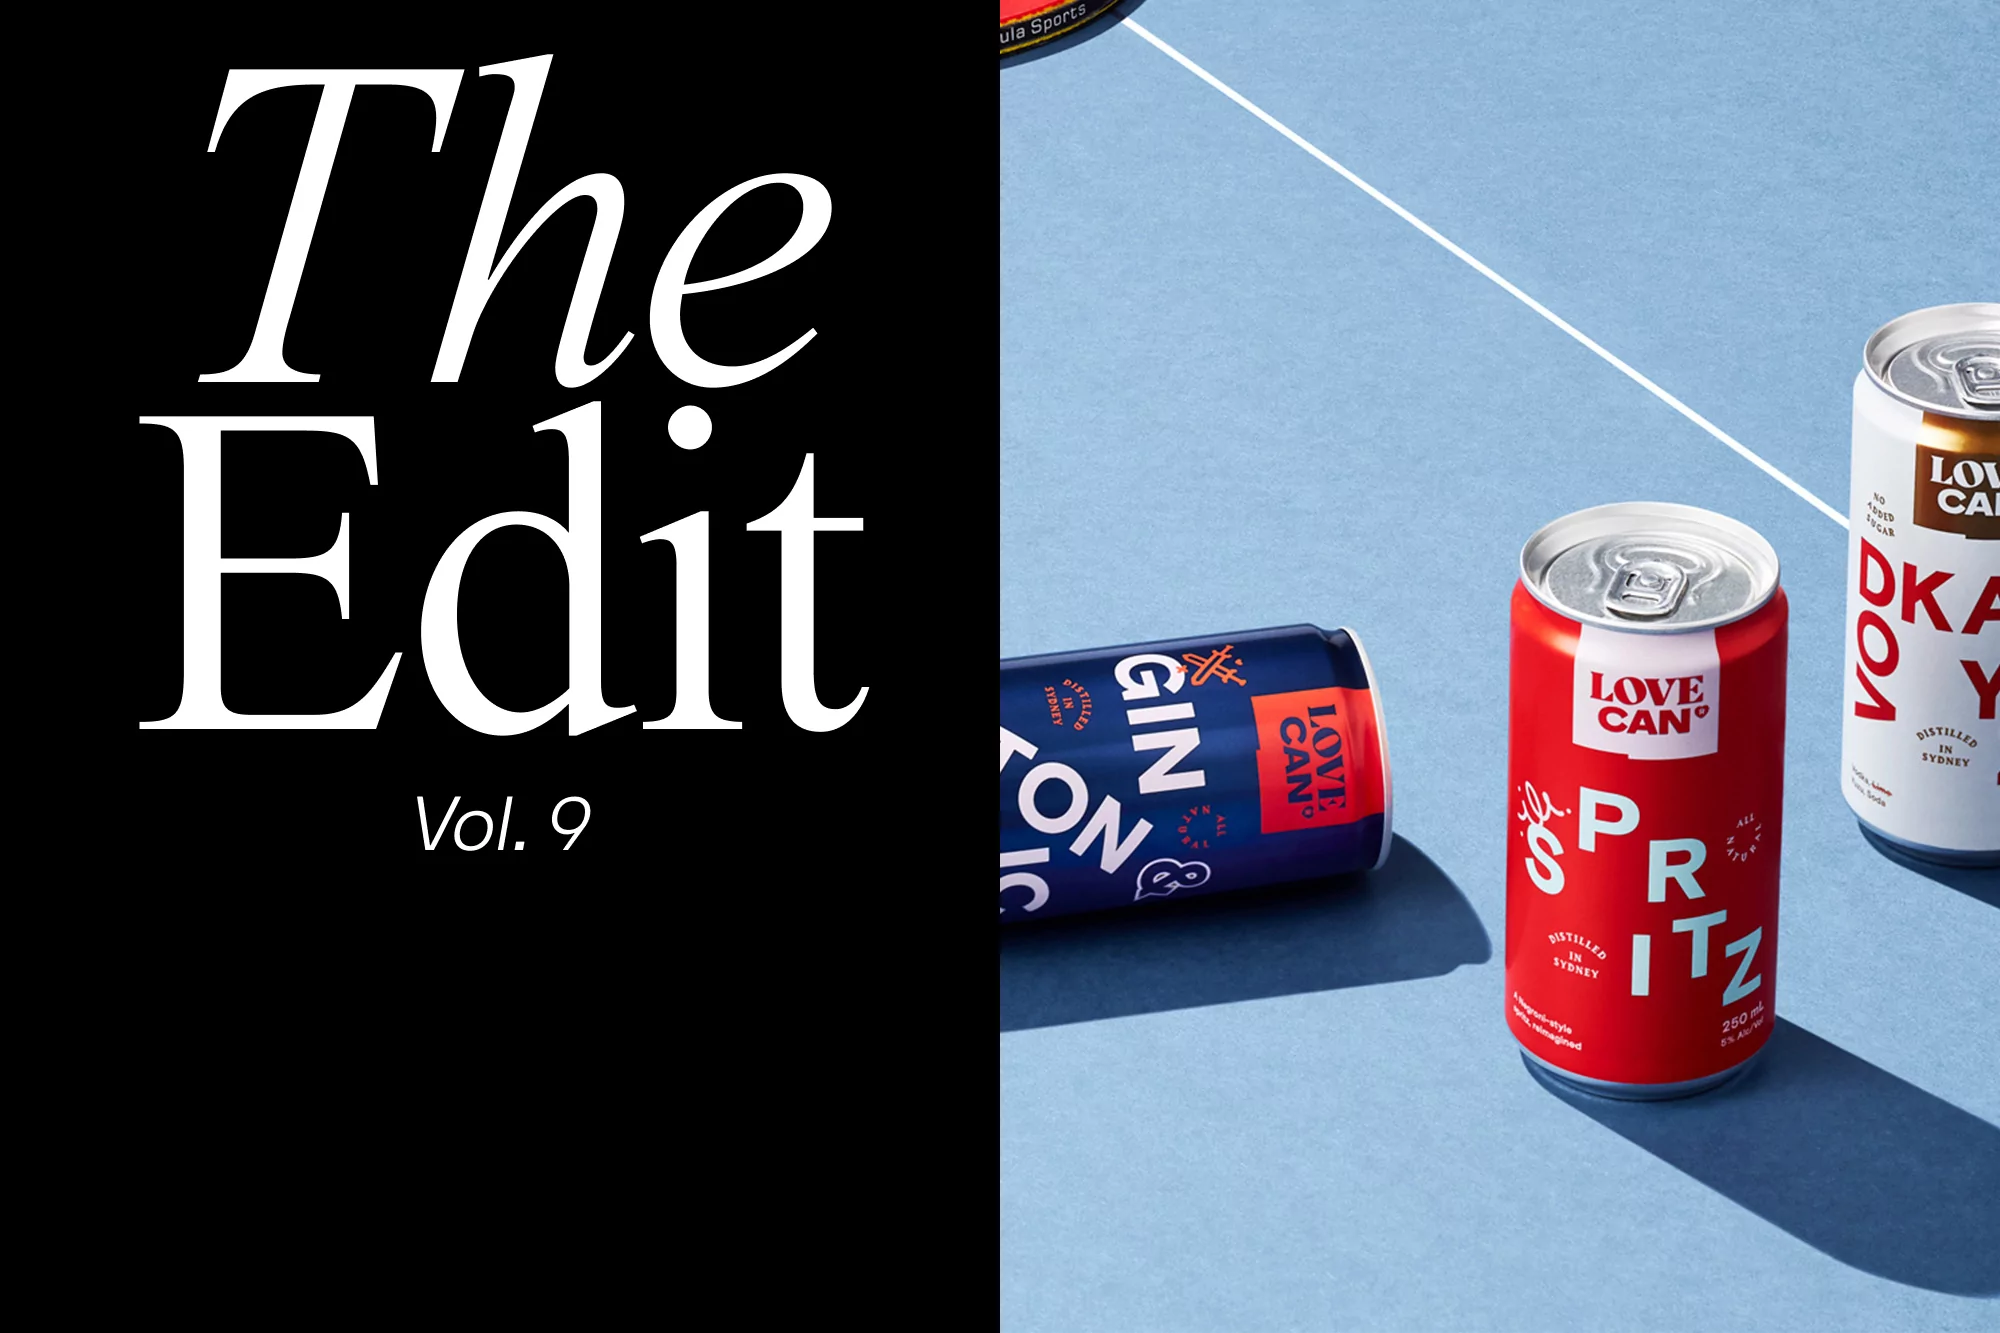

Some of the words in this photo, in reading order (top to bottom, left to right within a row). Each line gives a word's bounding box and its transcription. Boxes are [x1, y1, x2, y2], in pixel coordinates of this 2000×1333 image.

[1030, 3, 1087, 35] Sports
[1867, 501, 1895, 522] ADDED
[1873, 491, 1886, 505] NO
[1937, 488, 2000, 516] CA
[1866, 513, 1896, 537] SUGAR
[1590, 671, 1704, 706] LOVE
[1044, 686, 1063, 726] SYDNEY
[1062, 697, 1074, 709] IN
[1062, 678, 1092, 731] DISTILLED
[1114, 653, 1206, 795] GIN
[1597, 706, 1691, 735] CAN
[1916, 726, 1978, 748] DISTILLED
[1939, 744, 1953, 754] IN
[1280, 716, 1313, 804] CAN
[1307, 704, 1346, 811] LOVE
[1922, 752, 1970, 767] SYDNEY
[1177, 804, 1211, 849] NATURAL
[1215, 814, 1227, 837] ALL
[1736, 812, 1755, 828] ALL
[1726, 823, 1762, 862] NATURAL
[1548, 931, 1607, 960] DISTILLED
[1569, 950, 1582, 963] IN
[1553, 957, 1599, 979] SYDNEY
[1532, 1022, 1582, 1051] reimagined
[1722, 1012, 1748, 1033] 250
